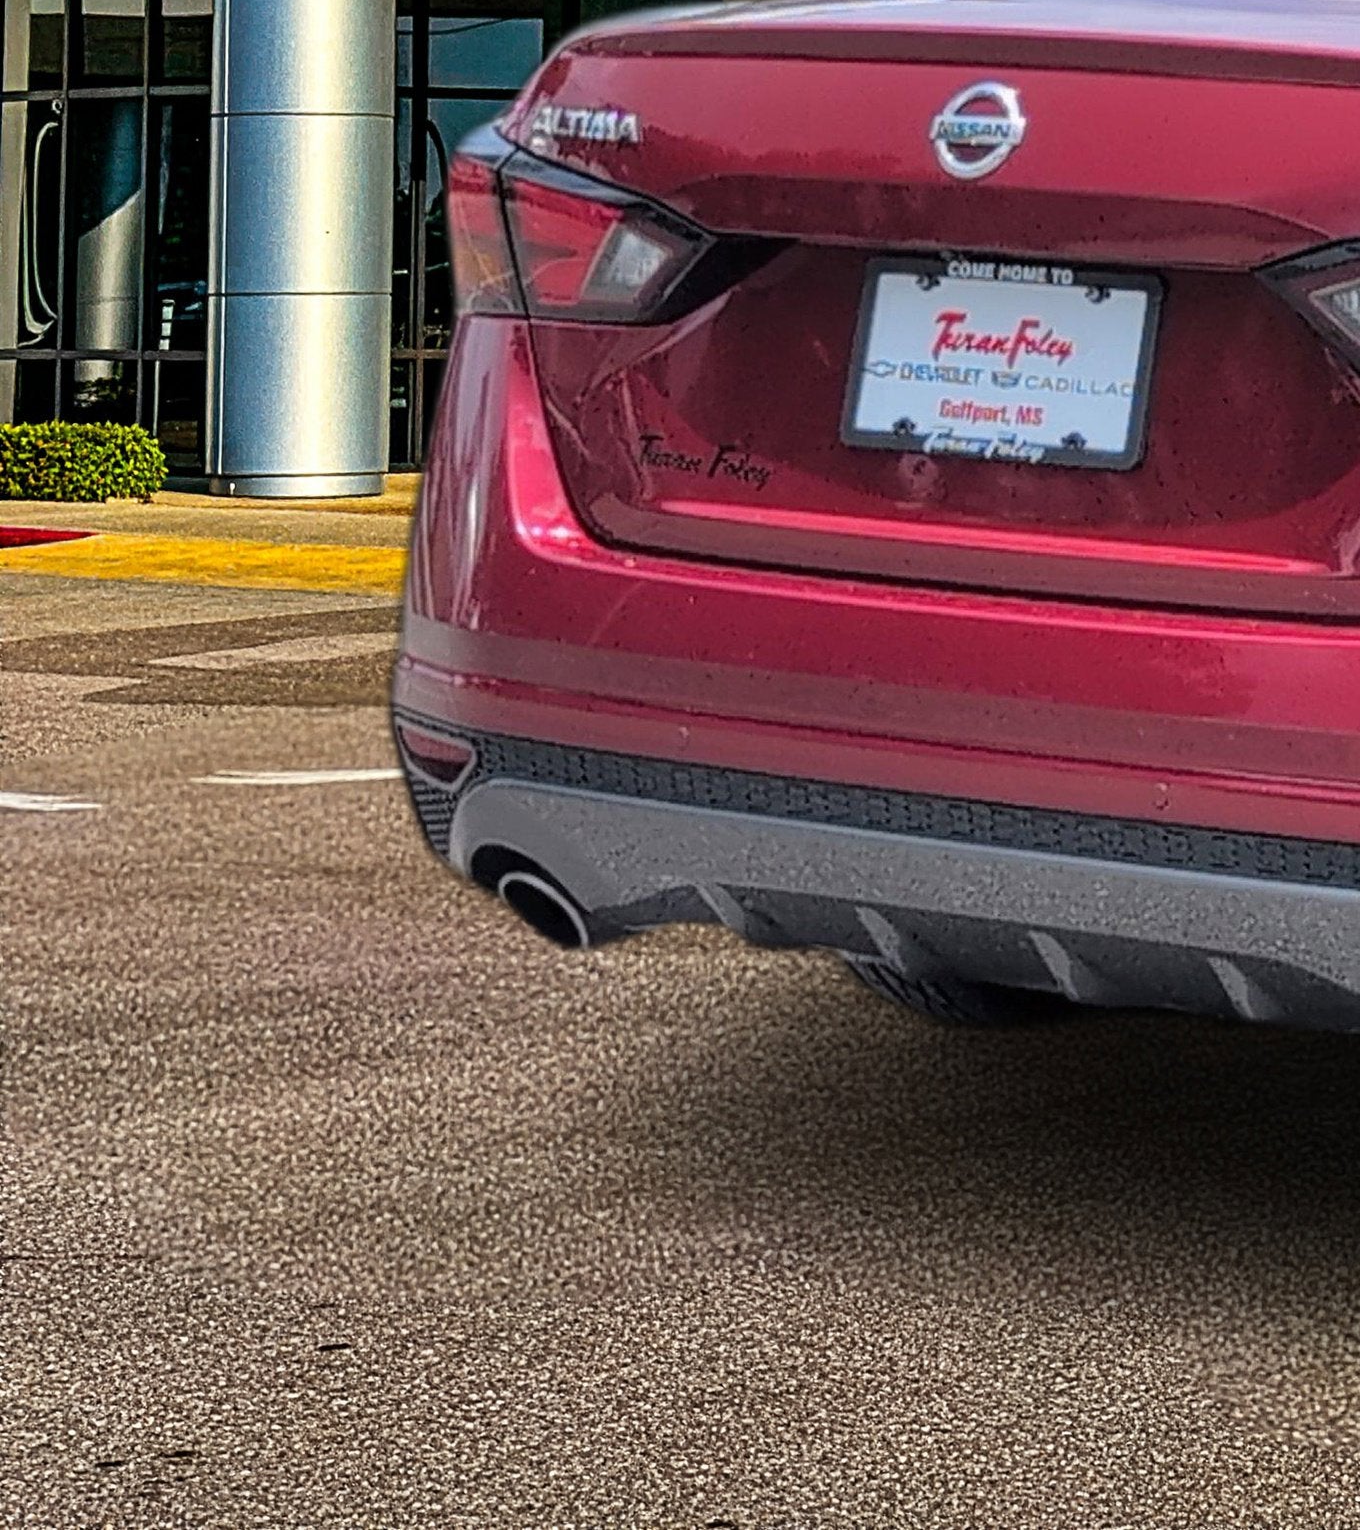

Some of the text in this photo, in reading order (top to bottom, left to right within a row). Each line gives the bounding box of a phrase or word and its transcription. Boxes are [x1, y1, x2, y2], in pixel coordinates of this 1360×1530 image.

[532, 106, 640, 143] ALTIMA
[936, 118, 1012, 141] NISSAN
[947, 260, 1074, 285] COME HOME TO
[1025, 375, 1135, 398] CADILLAC
[1016, 404, 1044, 427] MS
[639, 434, 770, 491] Turan Foley
